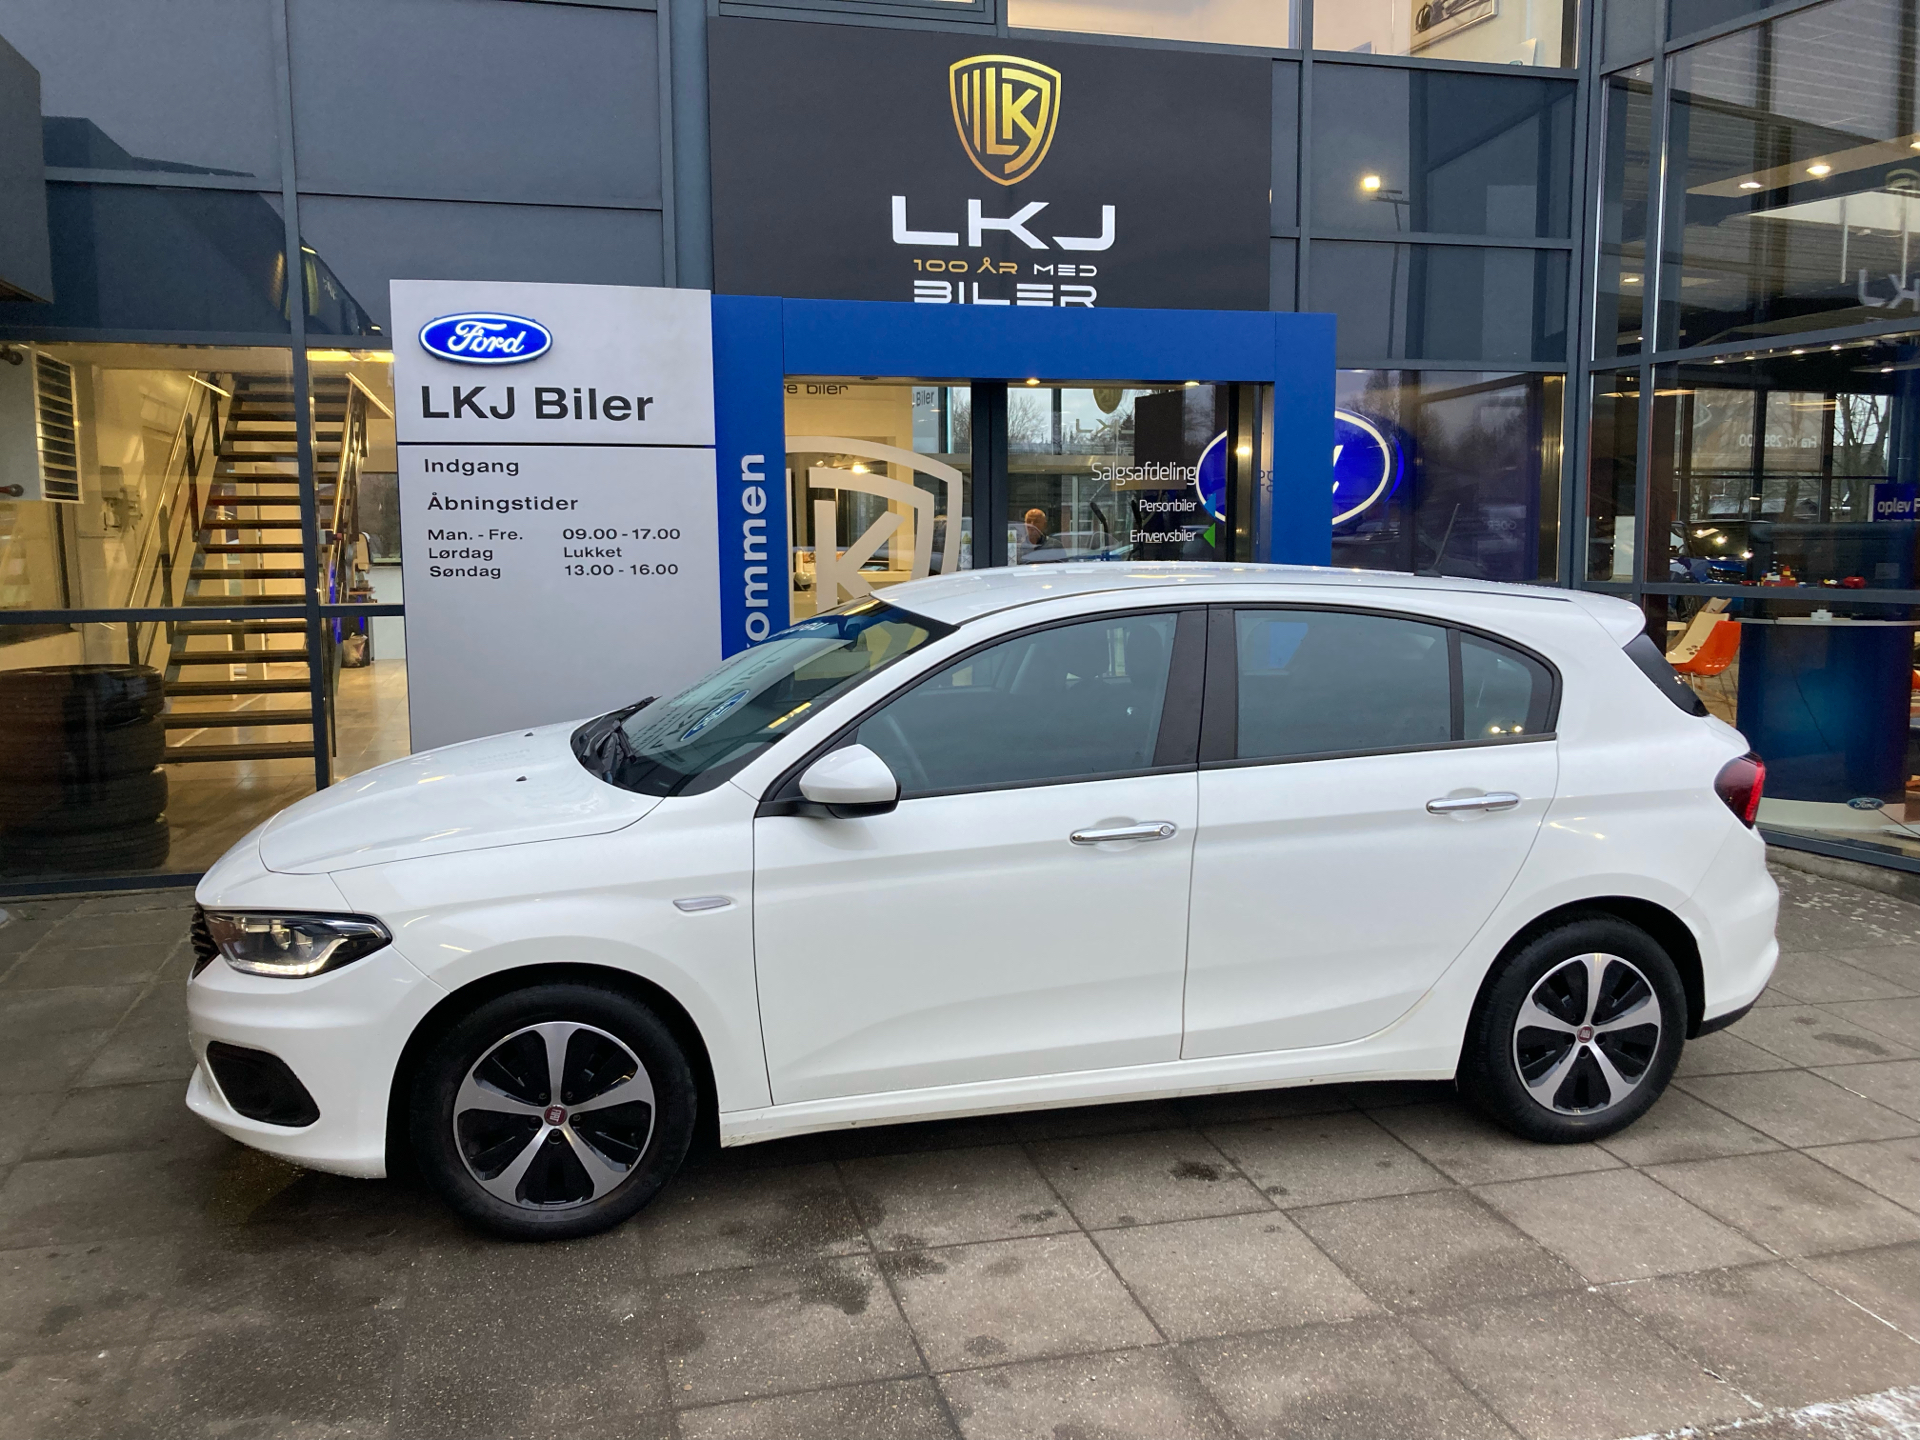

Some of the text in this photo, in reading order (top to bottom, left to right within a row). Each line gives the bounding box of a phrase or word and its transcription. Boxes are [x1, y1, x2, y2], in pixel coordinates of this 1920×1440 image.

[891, 195, 1116, 251] LKJ
[913, 256, 1098, 277] 100 ÅR MED
[913, 280, 1098, 308] BILER
[447, 320, 527, 353] Ford
[421, 385, 654, 422] LKJ Biler
[424, 458, 520, 477] Indgang
[1091, 461, 1197, 486] Salgsafdeling
[427, 491, 579, 514] Åbningstider
[1139, 499, 1198, 512] Personbiler
[1877, 497, 1912, 516] oplev
[427, 529, 473, 541] Man.
[489, 528, 523, 541] Fre.
[562, 528, 618, 540] 09.00
[631, 528, 681, 540] 17.00
[1130, 529, 1197, 543] Erhvervsbiler
[428, 546, 623, 562] Lørdag Lukket
[740, 454, 770, 648] ommen
[429, 565, 501, 580] Søndag
[564, 564, 614, 577] 13.00
[629, 563, 679, 576] 16.00
